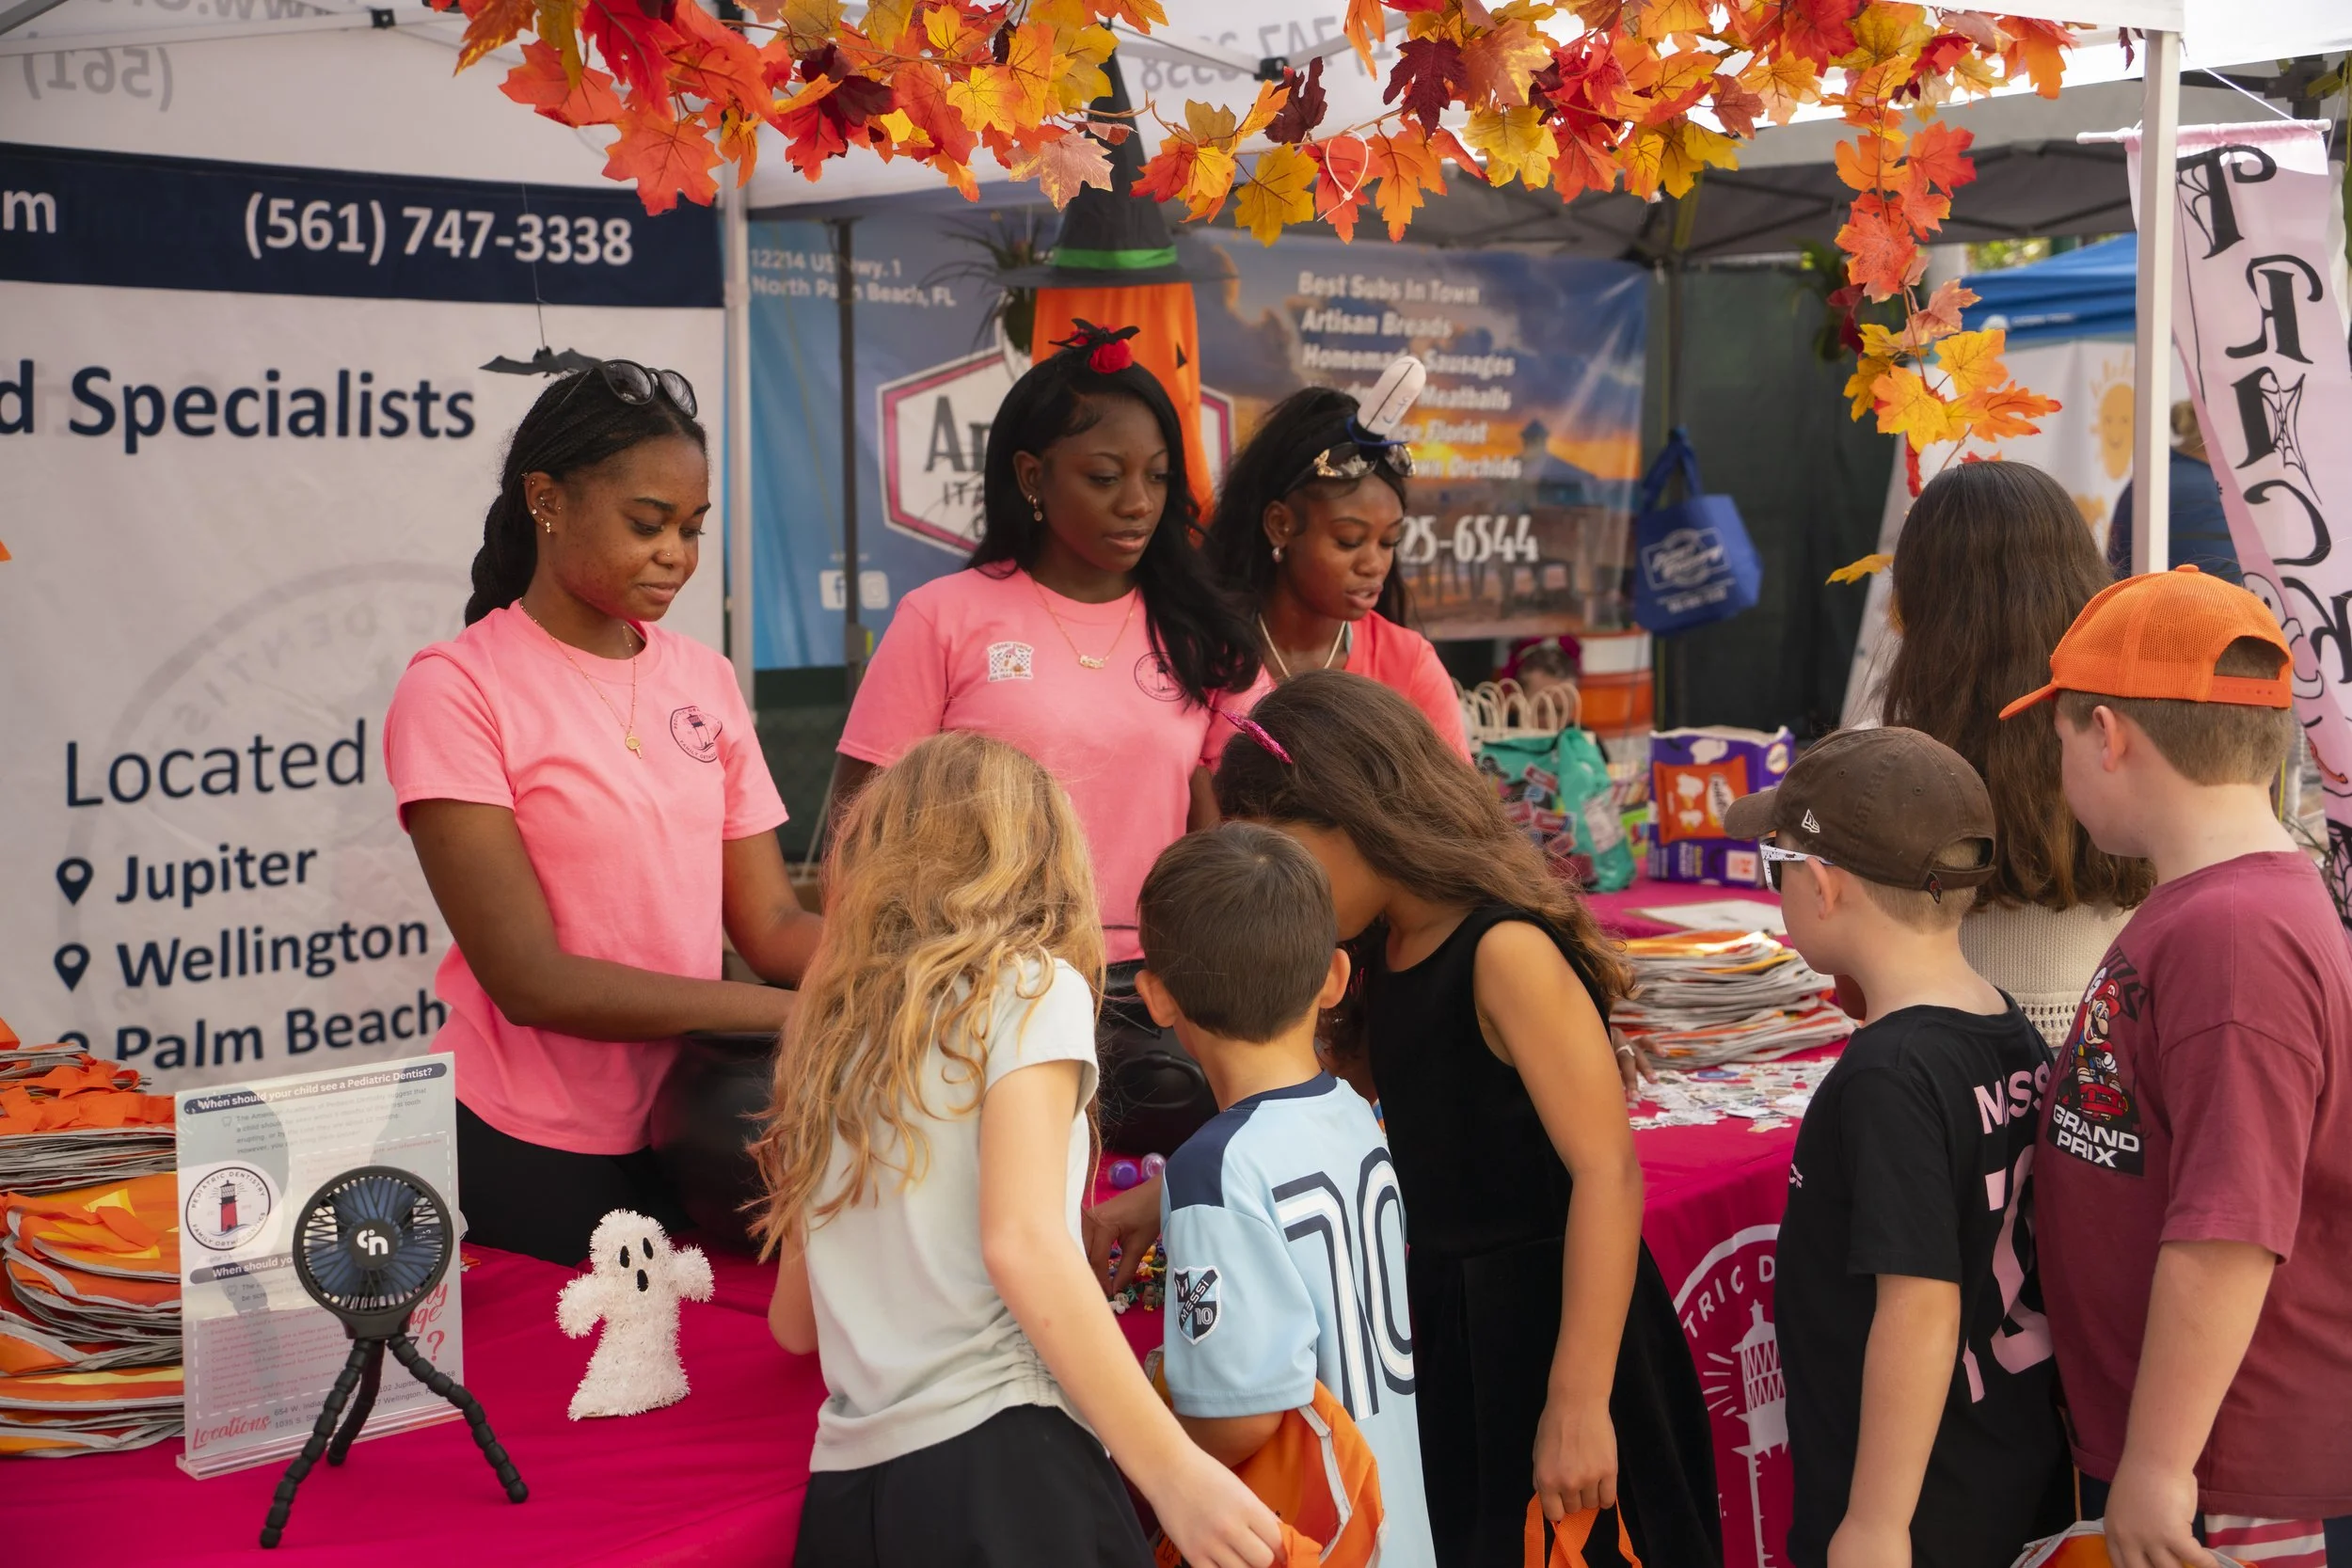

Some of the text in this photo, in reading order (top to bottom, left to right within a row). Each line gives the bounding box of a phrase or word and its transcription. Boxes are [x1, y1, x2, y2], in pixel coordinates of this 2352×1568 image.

[245, 192, 387, 265] (561)
[402, 206, 633, 266] 747-3338
[751, 250, 902, 279] 12214 US wy. 1
[752, 276, 958, 308] North Pam Beach, FL
[1297, 271, 1347, 297] Best
[1349, 273, 1402, 300] Subs
[1430, 278, 1480, 304] Town
[1301, 307, 1454, 339] Artisan Breads
[1423, 349, 1517, 381] Sausages
[69, 365, 476, 455] Specialists
[1417, 385, 1512, 410] Meatballs
[1425, 419, 1489, 444] Florist
[1448, 454, 1522, 480] Orchids
[1399, 515, 1539, 563] 25-6544
[66, 718, 367, 809] Located
[115, 843, 318, 908] Jupiter
[116, 918, 429, 988] Wellington
[115, 988, 448, 1070] Palm Beach
[199, 1067, 433, 1110] When should your child see a Pediatric Dentist?
[2053, 1103, 2140, 1152] GRAND
[2057, 1130, 2119, 1168] PRIX
[191, 1171, 266, 1209] PEDIATRIC DENTISTRY
[192, 1224, 213, 1245] FAMILY
[213, 1266, 242, 1277] When
[244, 1258, 278, 1272] should
[1271, 1146, 1417, 1423] 10
[1195, 1307, 1214, 1325] 10
